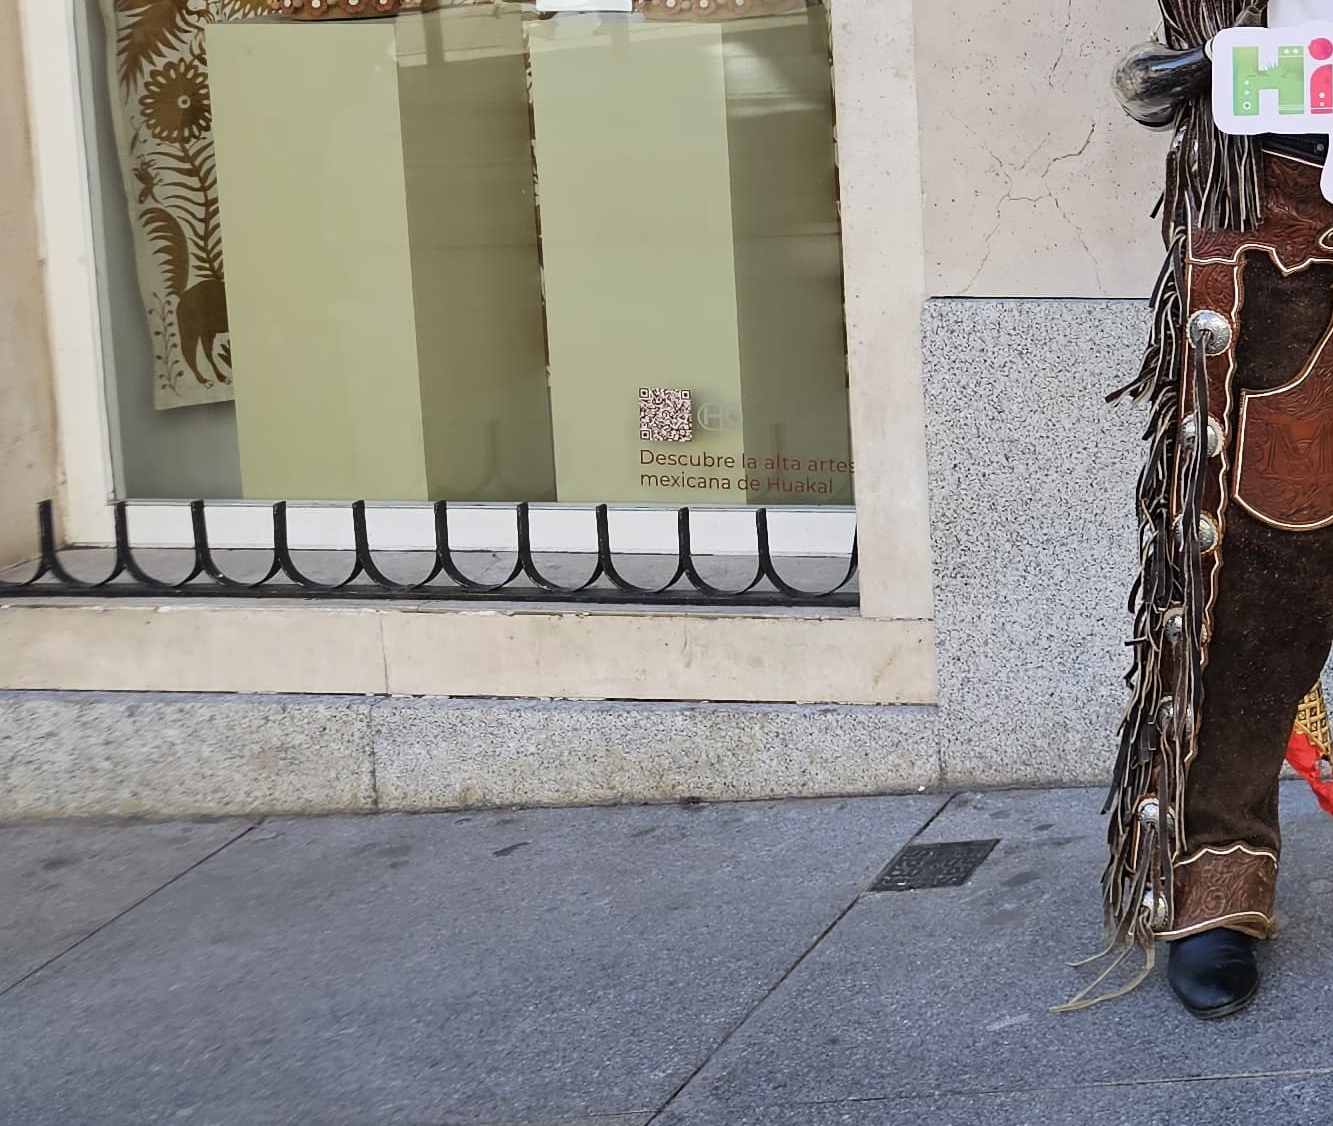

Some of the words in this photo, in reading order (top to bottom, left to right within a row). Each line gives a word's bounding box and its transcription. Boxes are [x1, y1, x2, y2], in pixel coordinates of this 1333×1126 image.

[640, 449, 735, 469] Descubre
[742, 453, 757, 469] la
[764, 453, 801, 471] alta
[640, 471, 731, 490] mexicana
[737, 475, 761, 491] de
[767, 476, 833, 494] Huakal
